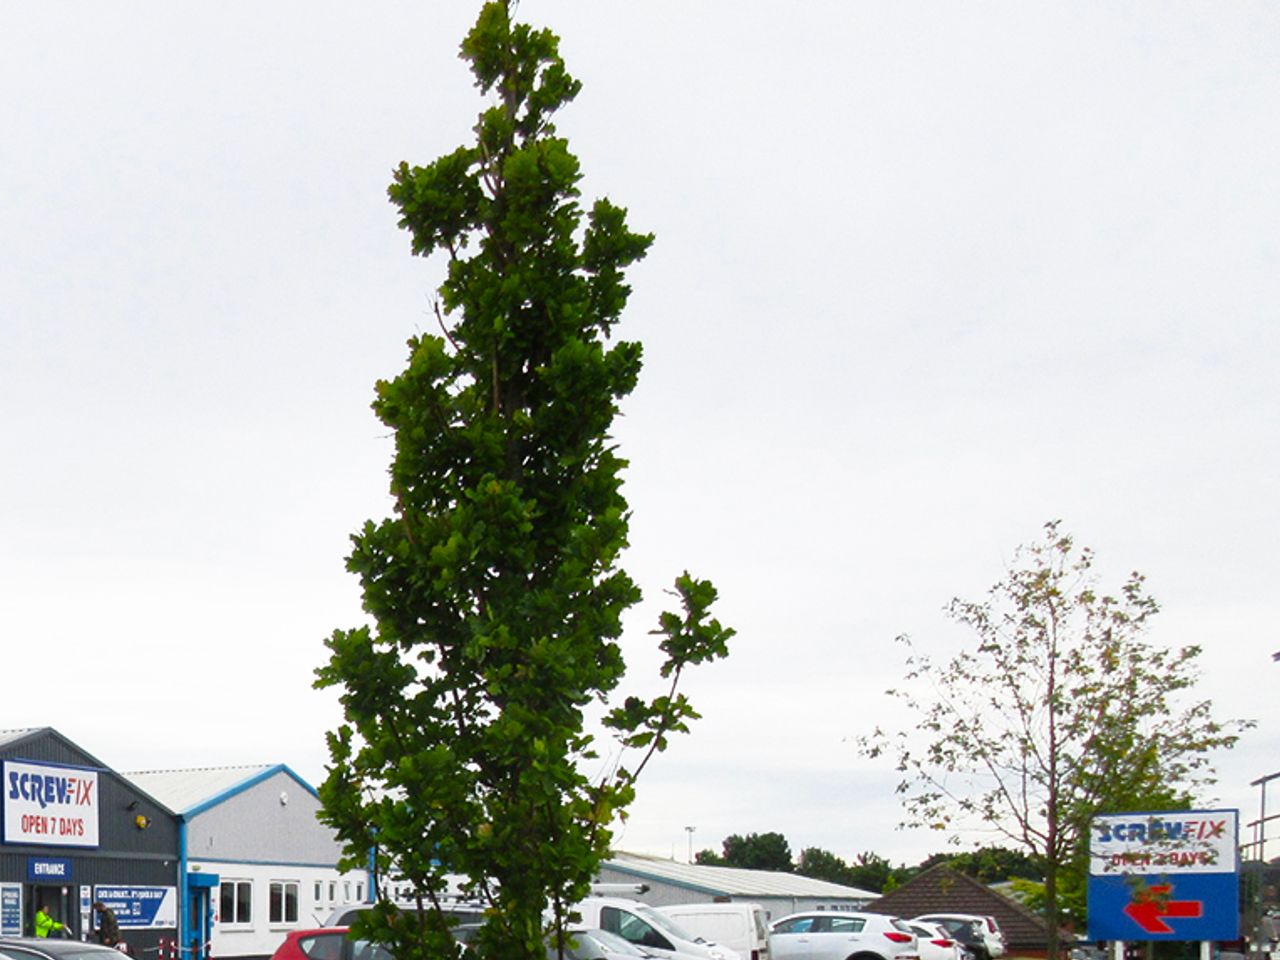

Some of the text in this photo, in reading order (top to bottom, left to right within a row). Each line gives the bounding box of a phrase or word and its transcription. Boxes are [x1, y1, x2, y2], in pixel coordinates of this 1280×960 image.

[21, 814, 84, 836] OPEN 7 DAYS
